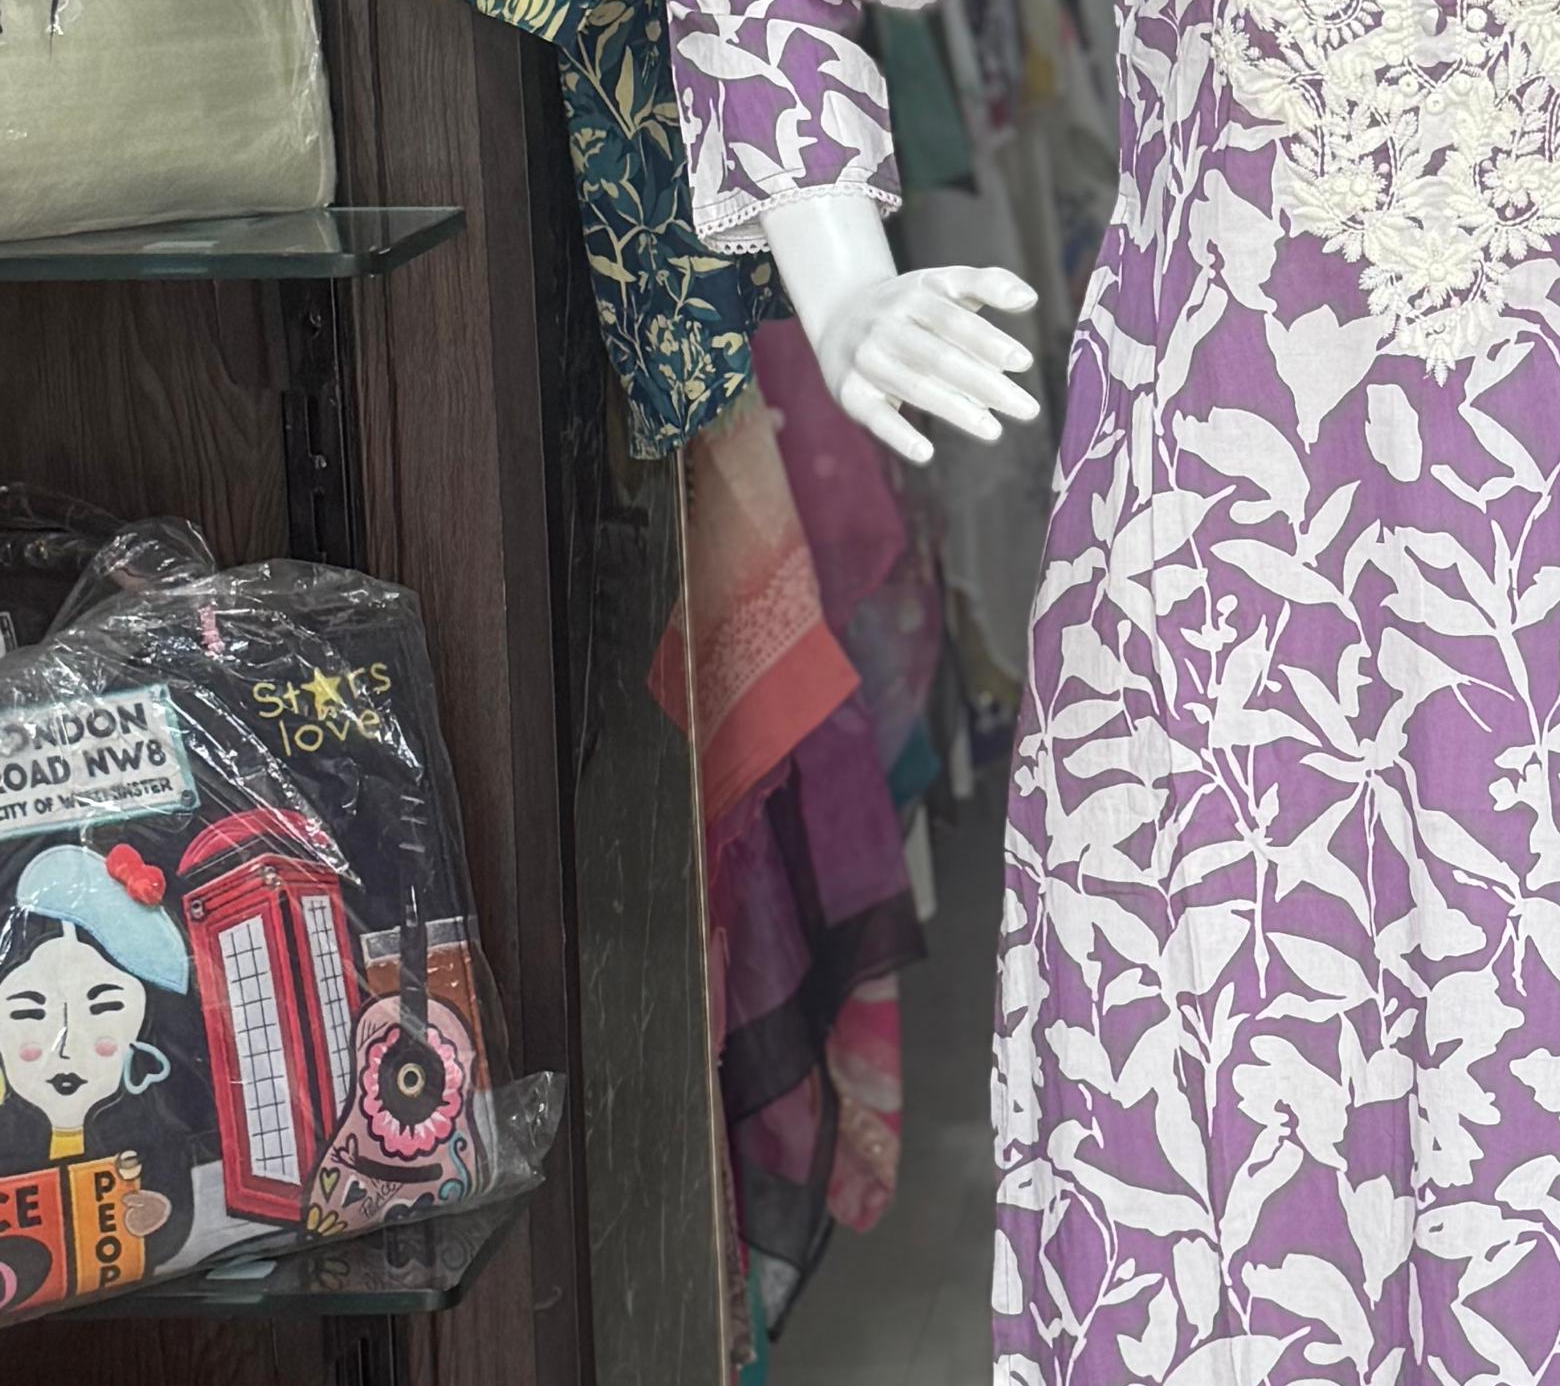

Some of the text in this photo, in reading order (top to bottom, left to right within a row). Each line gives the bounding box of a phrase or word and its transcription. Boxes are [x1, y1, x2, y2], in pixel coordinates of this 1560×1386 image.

[279, 709, 381, 757] love
[0, 738, 167, 795] OAD NW8
[34, 795, 55, 815] OF
